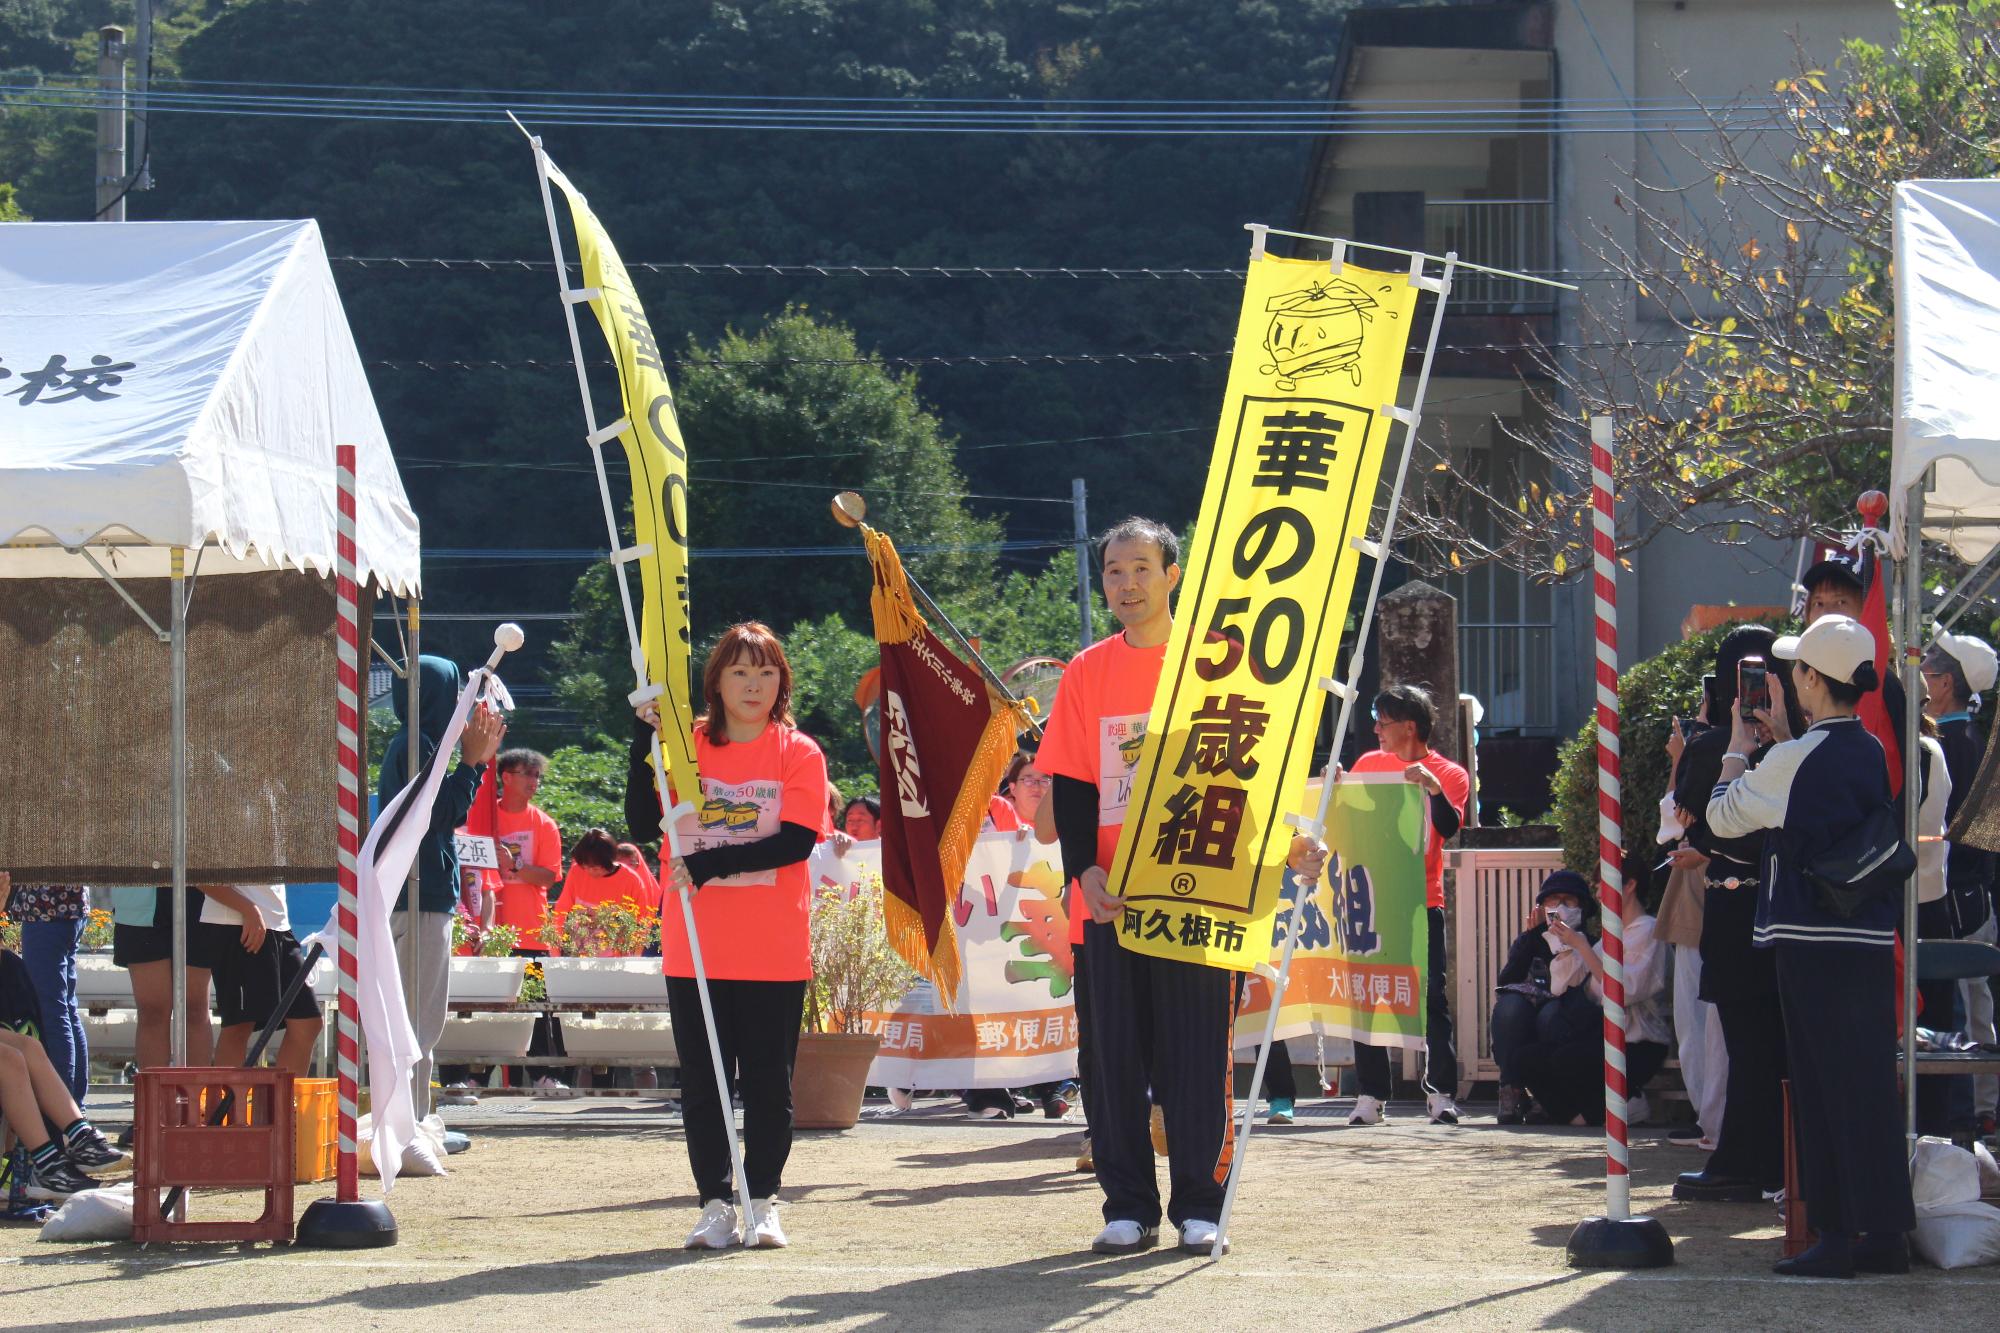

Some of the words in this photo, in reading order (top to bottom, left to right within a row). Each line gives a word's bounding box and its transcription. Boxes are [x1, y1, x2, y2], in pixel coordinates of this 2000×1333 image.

[0, 354, 137, 407] 校
[1150, 410, 1344, 870] 華の50歳組
[907, 634, 977, 706] 立大川小学校
[711, 785, 778, 800] 華の50歳組
[1121, 905, 1248, 953] 阿久根市
[1327, 967, 1412, 1008] 大川郵便局
